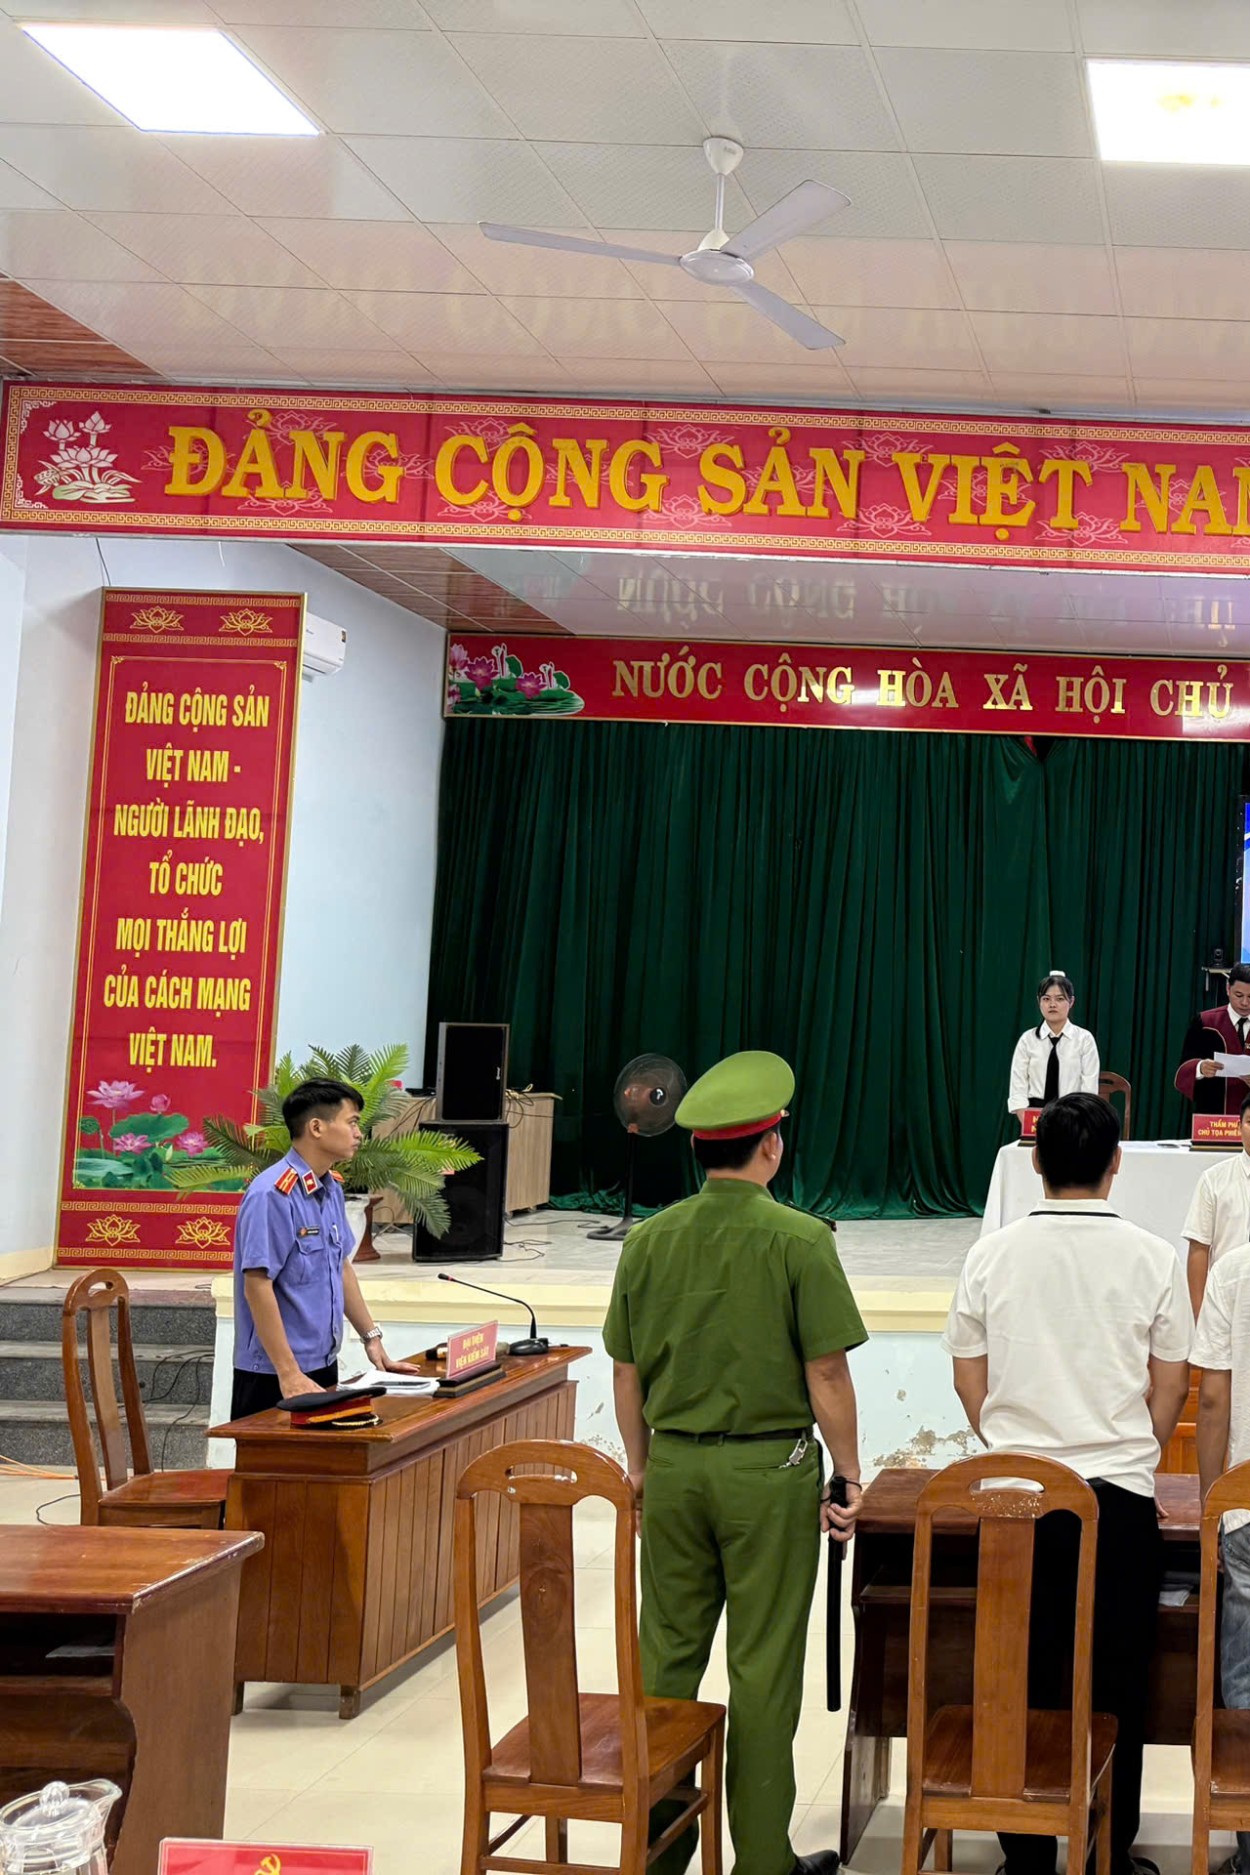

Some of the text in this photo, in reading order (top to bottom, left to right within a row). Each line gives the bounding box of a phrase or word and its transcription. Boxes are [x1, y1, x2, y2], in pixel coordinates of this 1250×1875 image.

[165, 406, 405, 502] ĐẢNG
[431, 423, 666, 526] CỘNG
[698, 424, 868, 518] SẢN
[890, 443, 1092, 545] VIỆT
[616, 642, 721, 698] NƯỚC
[745, 654, 858, 711] CỘNG
[873, 658, 958, 711] HÒA
[983, 664, 1033, 710] XÃ
[1056, 666, 1126, 723] HỘI
[1151, 659, 1234, 722] CHỦ
[126, 684, 269, 732] ĐẢNG CỘNG SẢN
[147, 743, 183, 787] VIỆT
[187, 750, 229, 782] NAM
[114, 798, 264, 846] NGƯỜI LÃNH ĐẠO,
[150, 850, 223, 895] TỔ CHỨC
[116, 909, 246, 960] MỌI THẮNG LỢI
[104, 965, 251, 1017] CỦA CÁCH MẠNG
[130, 1027, 216, 1072] VIỆT NAM.
